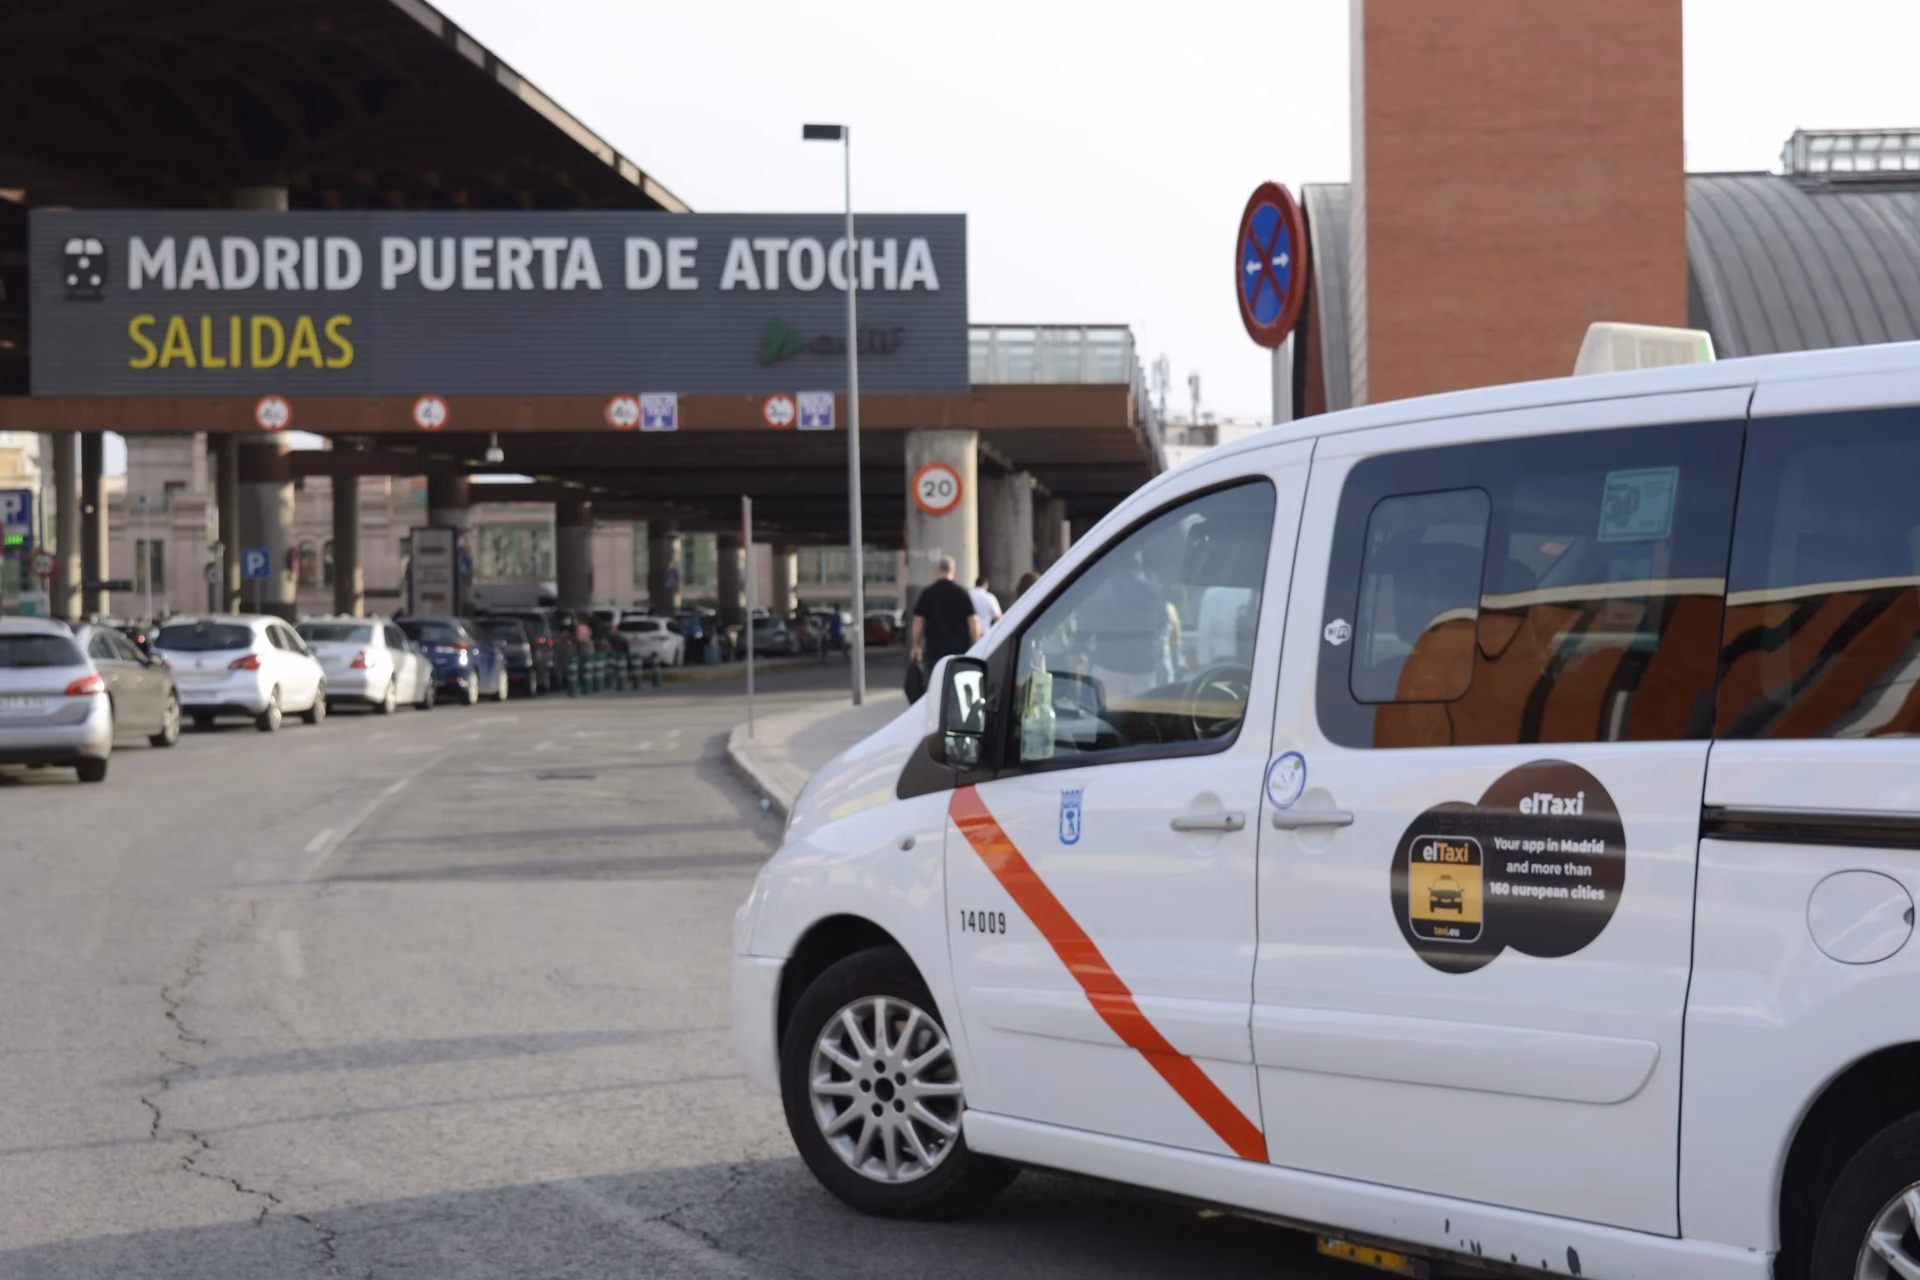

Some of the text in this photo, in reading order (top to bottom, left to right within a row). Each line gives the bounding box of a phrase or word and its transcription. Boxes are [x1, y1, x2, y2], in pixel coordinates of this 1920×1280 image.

[128, 237, 940, 291] MADRID PUERTA DE ATOCHA
[129, 314, 355, 369] SALIDAS
[923, 480, 952, 498] 20
[247, 553, 265, 576] P
[1519, 791, 1585, 816] elTaxi
[1422, 841, 1469, 862] elTaxi
[1494, 837, 1604, 854] Your app in Madrid
[1506, 861, 1592, 877] and more than
[1490, 882, 1605, 901] 160 european cities
[960, 910, 1006, 934] 14009
[1433, 926, 1461, 938] taxi.eu
